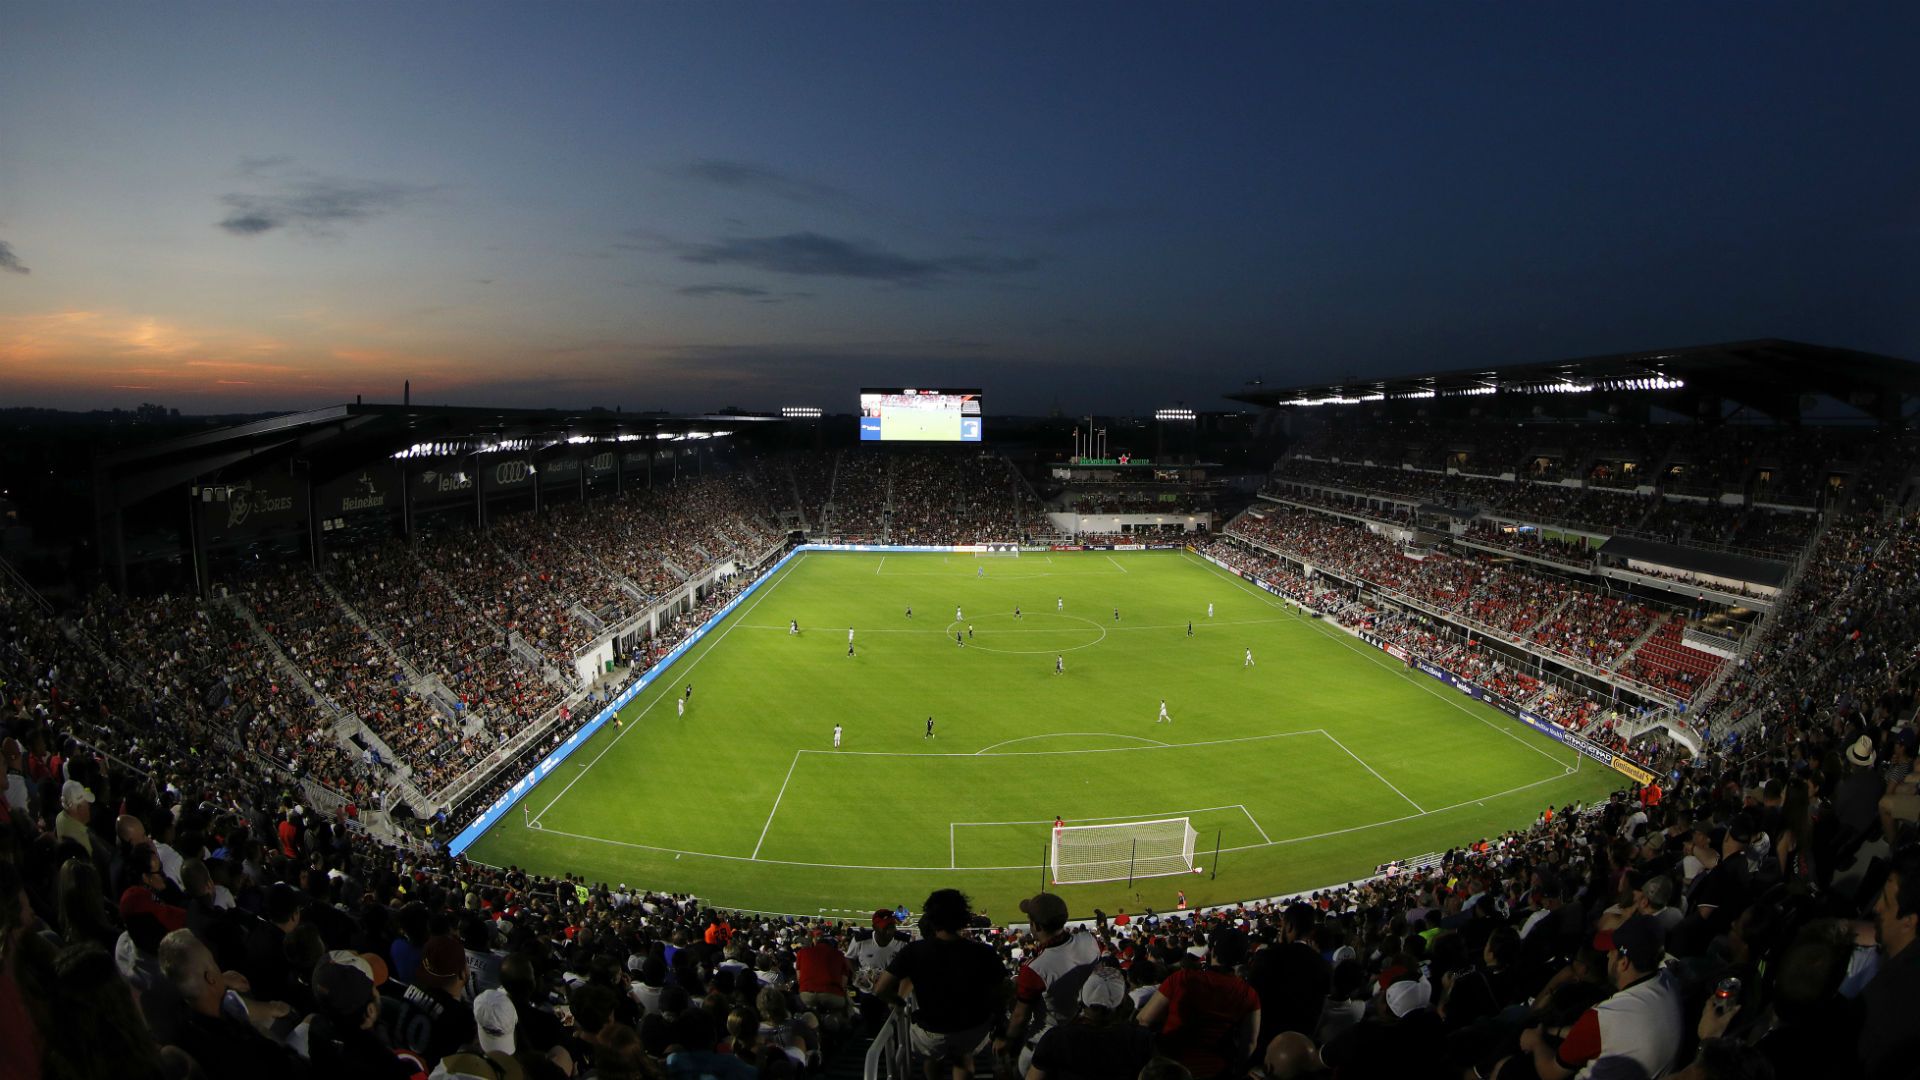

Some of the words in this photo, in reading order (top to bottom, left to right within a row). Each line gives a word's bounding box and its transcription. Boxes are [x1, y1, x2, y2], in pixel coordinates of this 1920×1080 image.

[342, 495, 384, 511] Heineken
[1588, 745, 1612, 761] ETIHAD
[1613, 758, 1645, 782] Continental
